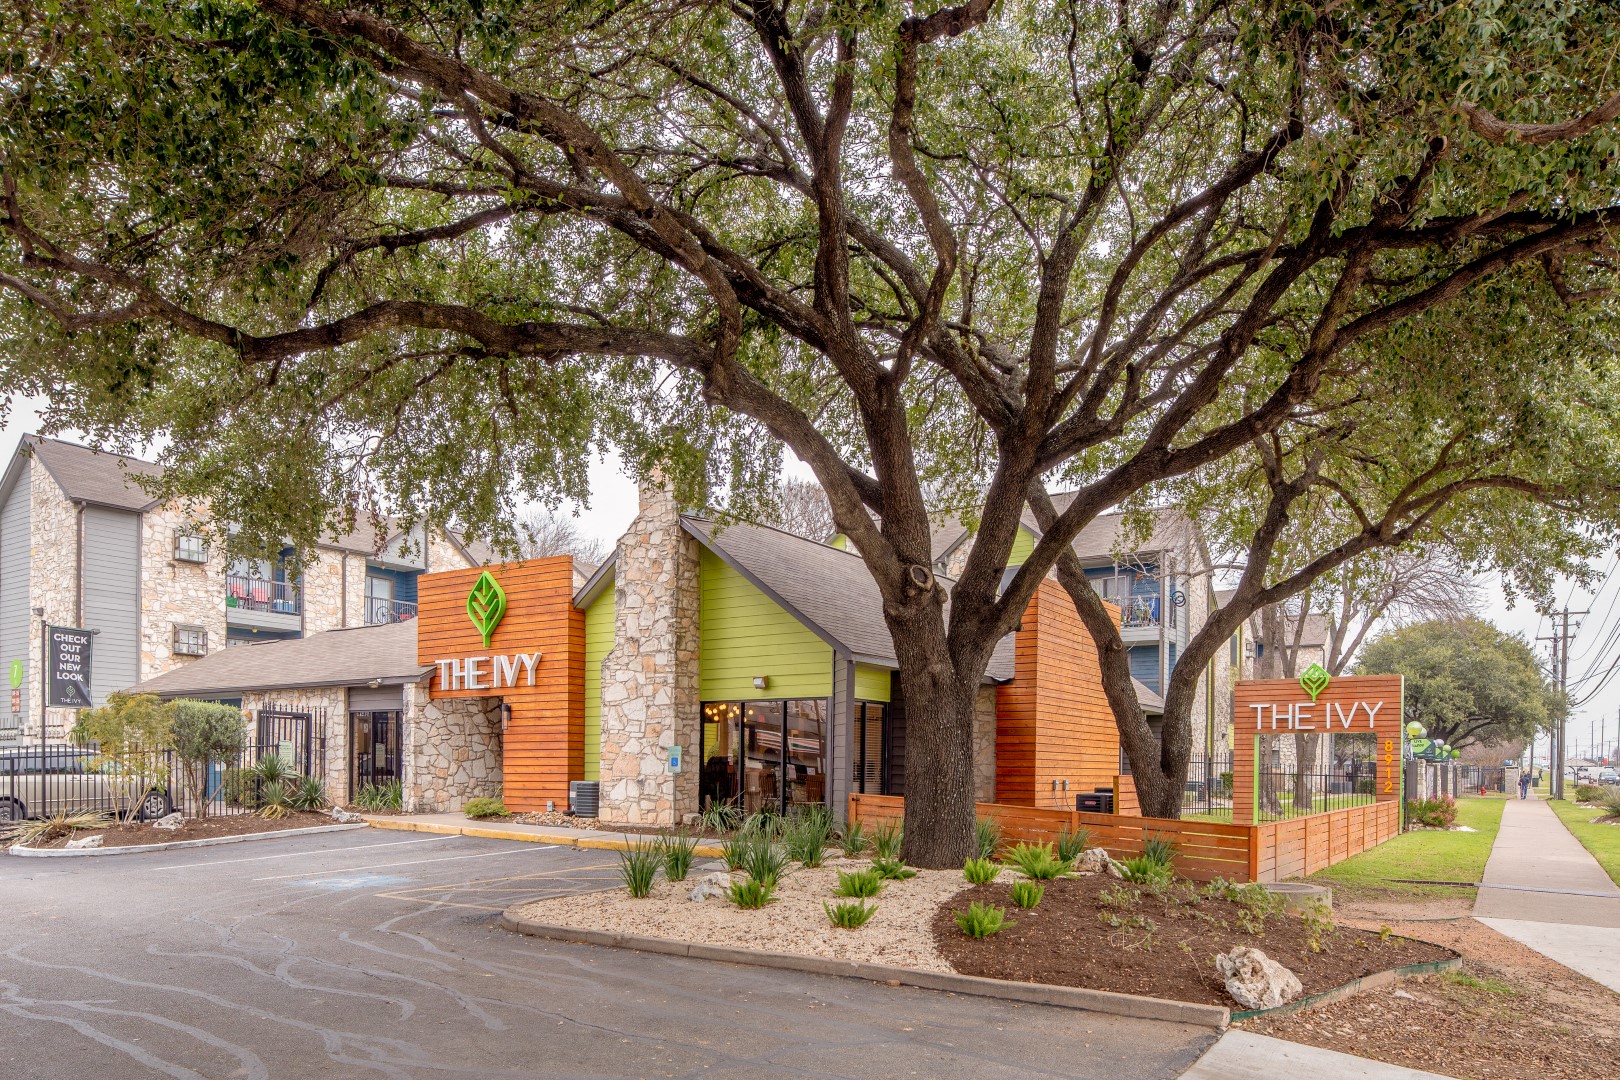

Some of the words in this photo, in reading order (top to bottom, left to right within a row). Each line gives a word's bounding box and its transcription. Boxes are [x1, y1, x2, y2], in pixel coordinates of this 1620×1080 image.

[53, 633, 88, 644] CHECK
[60, 643, 81, 653] OUT
[60, 653, 81, 663] OUR
[59, 662, 81, 671] NEW
[435, 656, 490, 691] THE
[493, 652, 542, 688] IVY
[56, 671, 84, 682] LOOK
[1249, 702, 1316, 730] THE
[1326, 701, 1384, 729] IVY
[1384, 739, 1394, 793] 8912
